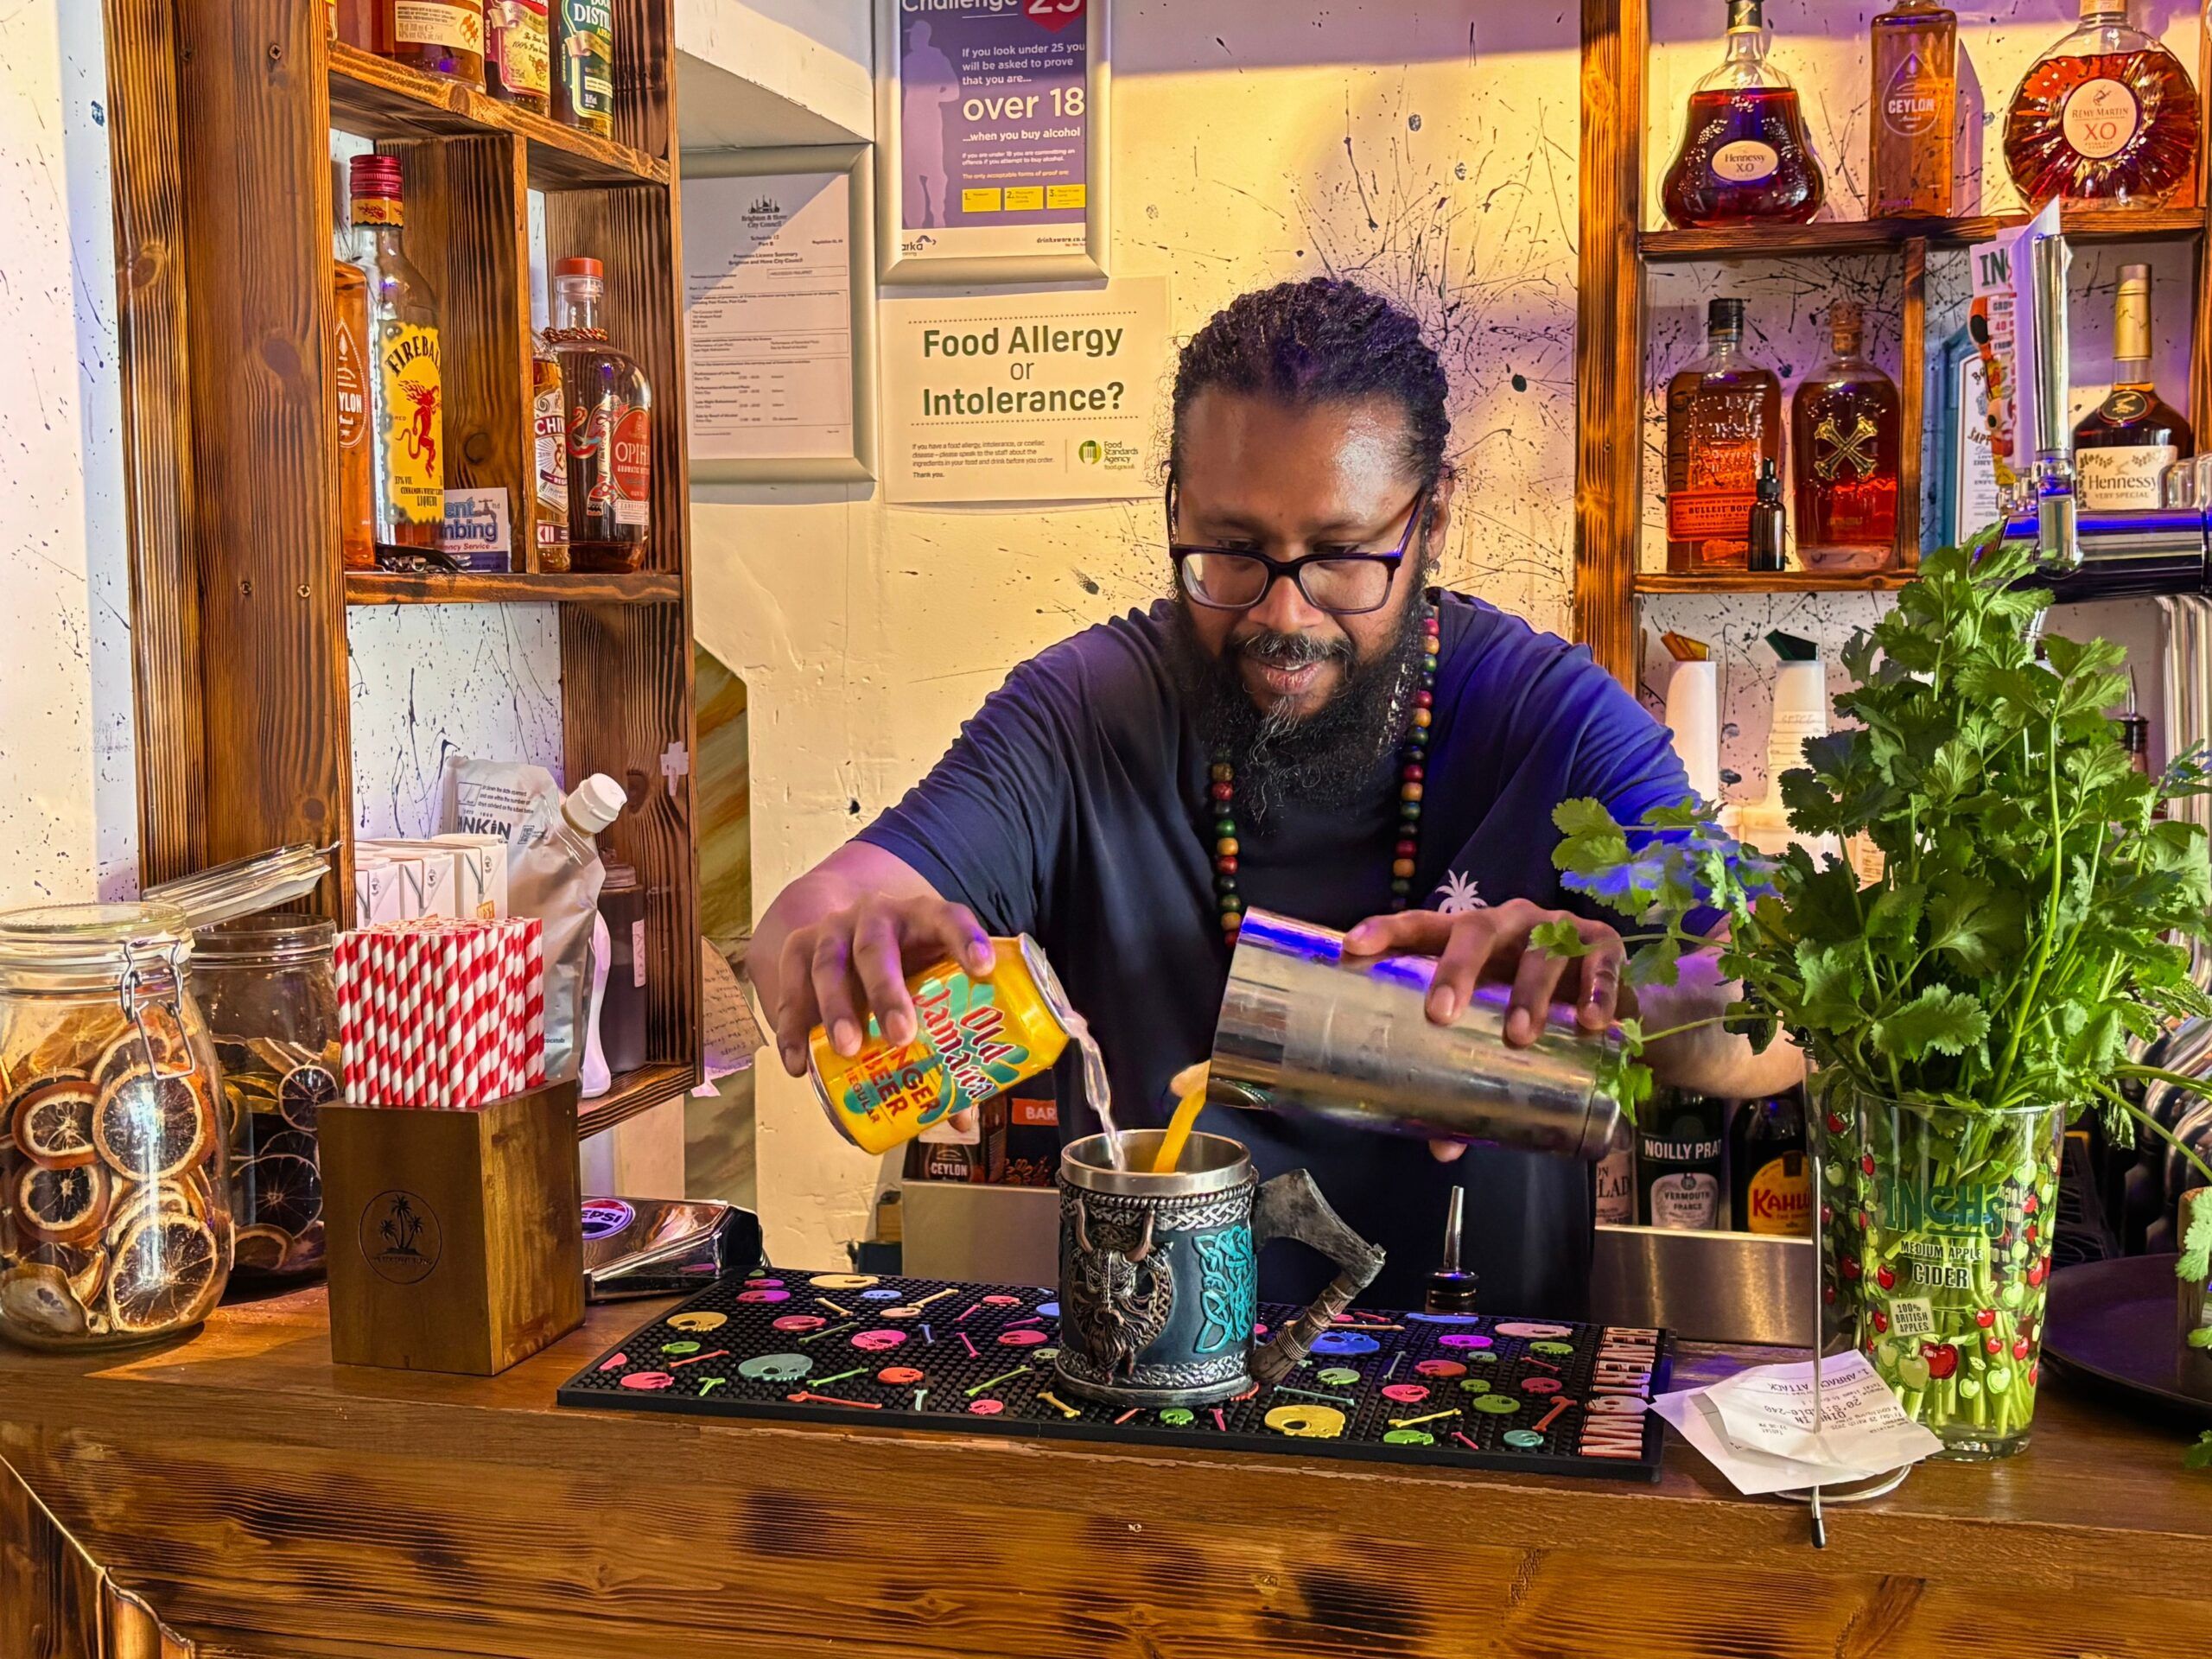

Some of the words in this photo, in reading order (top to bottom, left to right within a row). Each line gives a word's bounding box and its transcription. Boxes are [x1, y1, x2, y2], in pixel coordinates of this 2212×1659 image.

[963, 48, 969, 57] If
[972, 48, 990, 58] you
[994, 46, 1016, 55] look
[1019, 44, 1048, 55] under
[1051, 43, 1064, 53] 25
[1066, 43, 1085, 53] you
[963, 61, 980, 71] will
[982, 60, 995, 70] be
[998, 59, 1027, 69] asked
[1031, 59, 1041, 68] to
[1044, 58, 1073, 69] prove
[963, 76, 982, 86] that
[985, 77, 1004, 86] you
[963, 95, 1039, 121] over
[1050, 86, 1085, 118] 18
[1888, 98, 1935, 114] CEYLON
[1000, 131, 1019, 143] you
[1021, 129, 1040, 141] buy
[1043, 127, 1080, 138] alcohol
[2083, 122, 2117, 141] XO
[1725, 154, 1765, 163] Hennessy
[1979, 248, 2008, 287] IN
[924, 327, 999, 357] Food
[1007, 325, 1123, 357] Allergy
[385, 335, 442, 378] FIREBAL
[1010, 362, 1034, 380] or
[924, 382, 1124, 416] Intolerance?
[2088, 475, 2157, 491] Hennessy
[1688, 505, 1726, 514] BULLEIT
[959, 1006, 1017, 1065] Old
[912, 988, 995, 1100] Jamaica
[1644, 1139, 1690, 1160] NOILLY
[931, 1162, 968, 1176] CEYLON
[1664, 1191, 1711, 1200] VERMOUTH
[582, 1210, 623, 1224] EPSI
[1901, 1241, 1943, 1258] MEDIUM
[1949, 1246, 1983, 1261] APPLE
[1913, 1264, 1970, 1289] CIDER
[1897, 1303, 1922, 1313] 100%
[1895, 1313, 1929, 1324] BRITISH
[1899, 1322, 1929, 1333] APPLES
[1768, 1383, 1808, 1392] ATTACK
[1820, 1372, 1856, 1388] ARRAC
